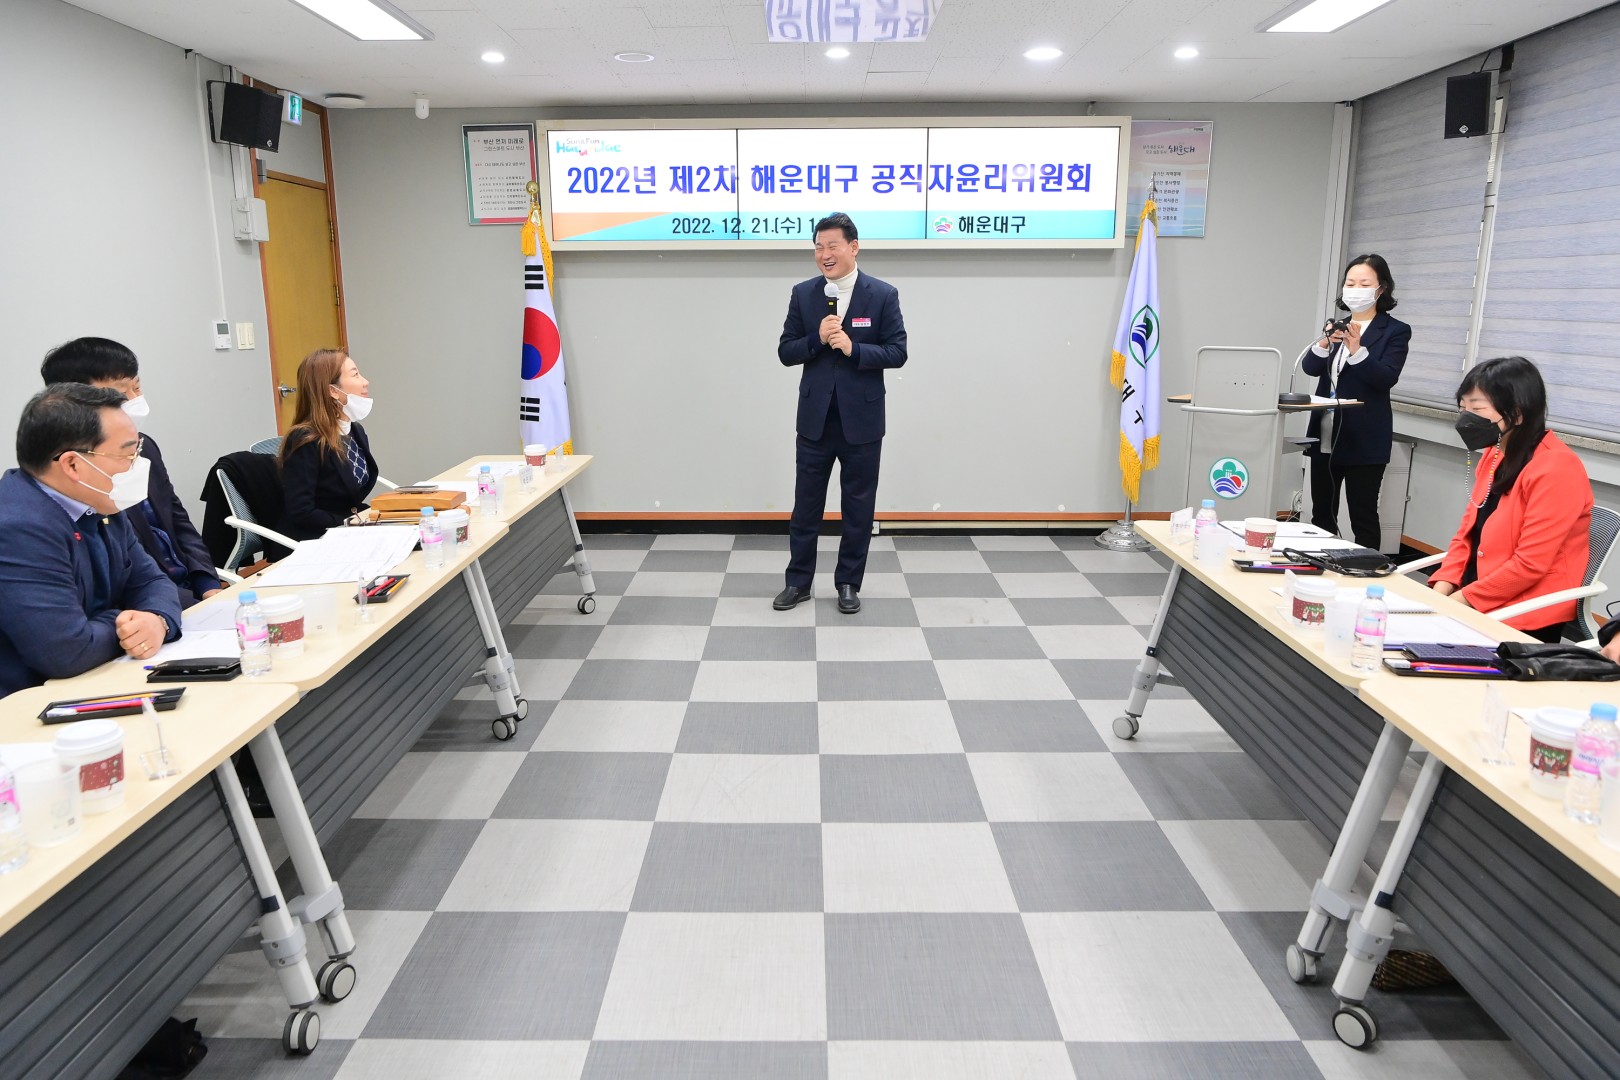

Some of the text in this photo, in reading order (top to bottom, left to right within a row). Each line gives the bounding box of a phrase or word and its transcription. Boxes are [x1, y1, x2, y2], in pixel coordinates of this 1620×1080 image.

[567, 163, 1092, 194] 2022년 제2차 해운대구 공직자윤리위원회
[672, 217, 715, 234] 2022.
[722, 217, 746, 234] 12.
[958, 215, 1026, 234] 해운대구
